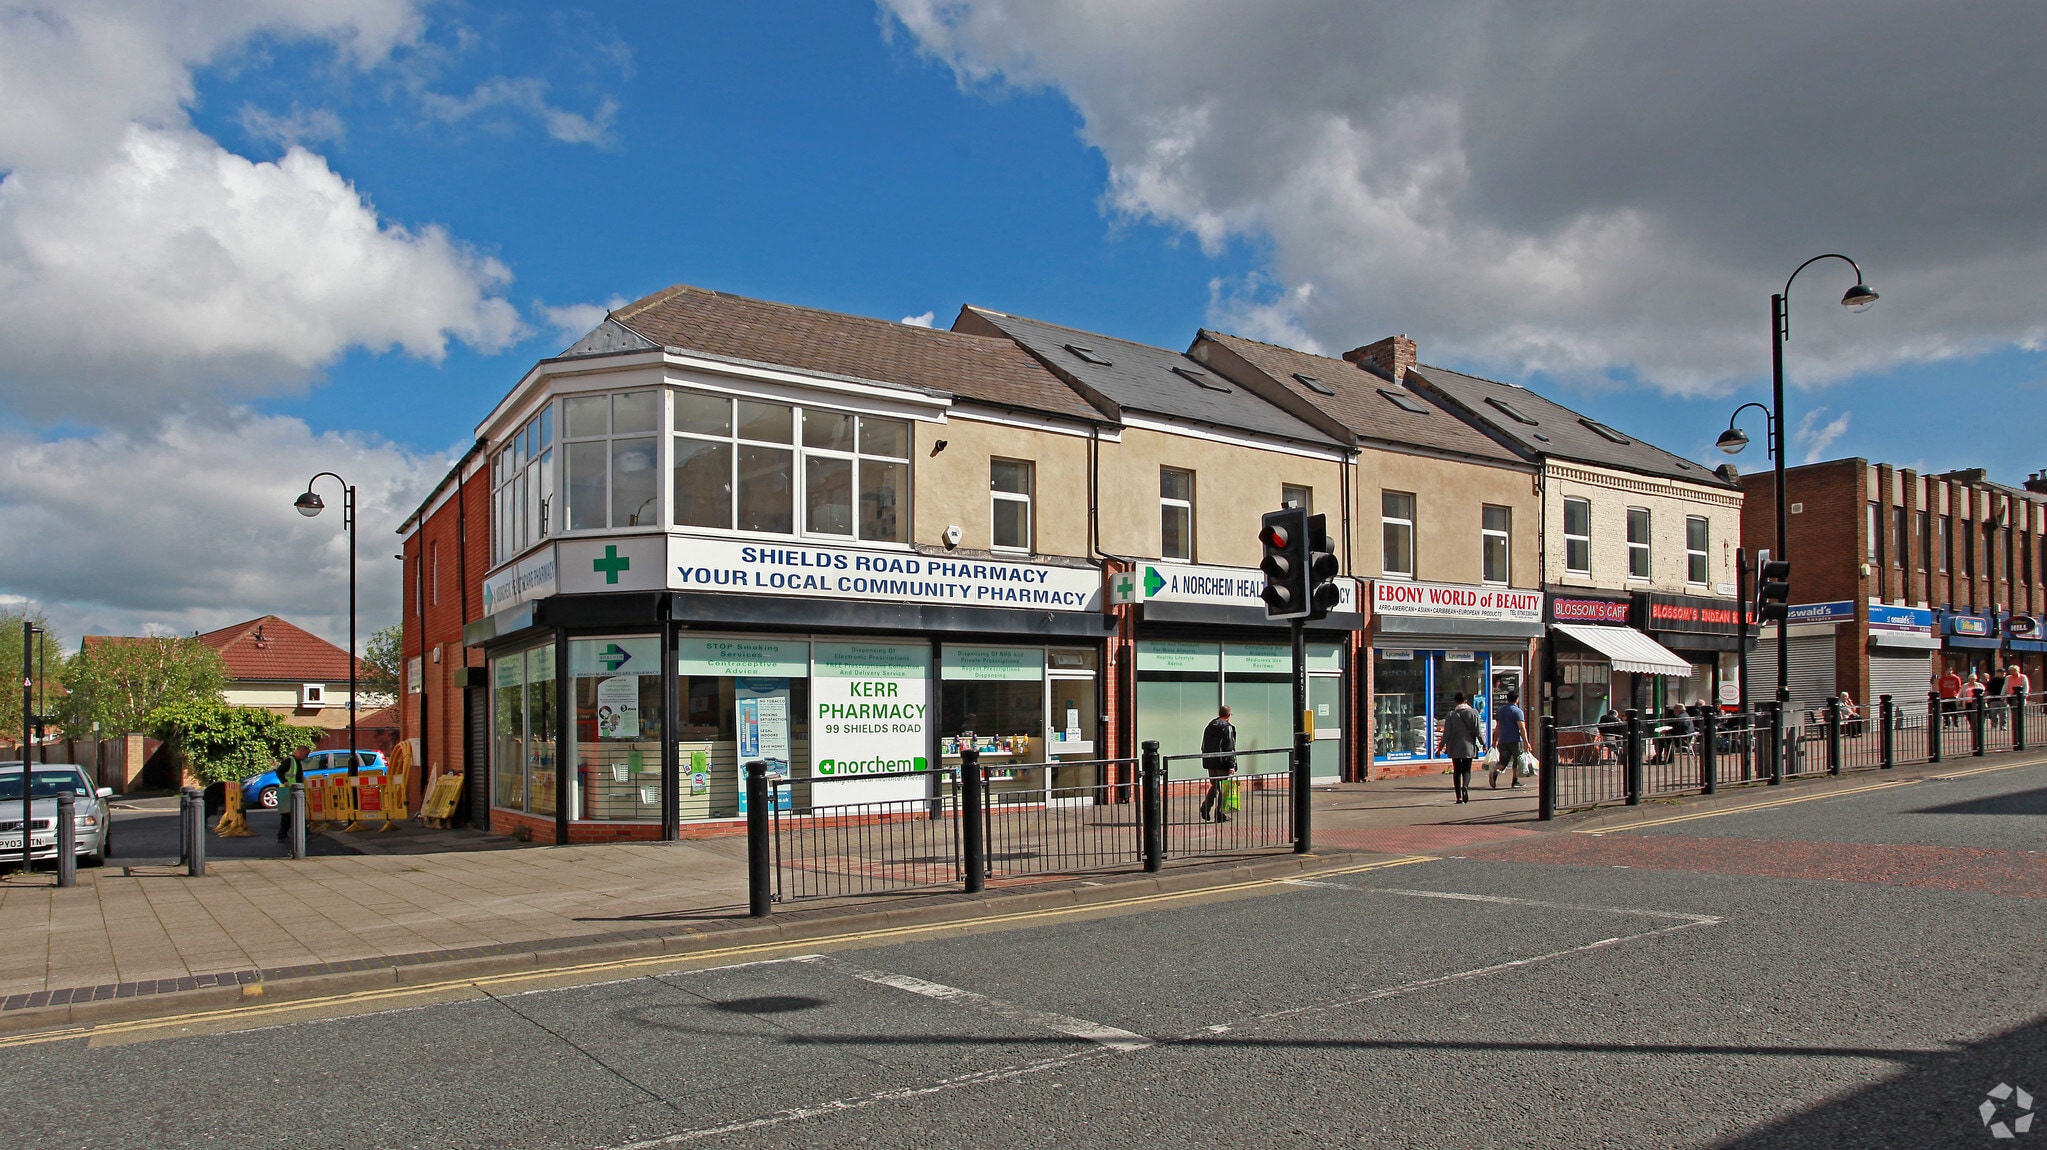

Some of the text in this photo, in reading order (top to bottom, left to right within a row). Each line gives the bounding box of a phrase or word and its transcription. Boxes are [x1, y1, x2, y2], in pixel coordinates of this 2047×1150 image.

[741, 546, 1048, 583] SHIELDS ROAD PHARMACY
[677, 566, 1086, 606] YOUR LOCAL COMMUNITY PHARMACY
[1171, 574, 1179, 593] A
[1183, 575, 1233, 597] NORCHEM
[1378, 585, 1540, 610] EBONY WORLD of BEAUTY
[1555, 602, 1605, 617] BLOSSOM'S
[1652, 605, 1698, 620] BLOSSOM'S
[1701, 609, 1730, 622] INDIAN
[736, 644, 779, 652] Smoking
[851, 647, 886, 655] Dispensing
[957, 650, 990, 658] Dispensing
[707, 660, 777, 668] Contraceptive
[834, 653, 867, 661] Electronic
[854, 669, 880, 677] Delivery
[850, 681, 898, 697] KERR
[819, 703, 927, 719] PHARMACY
[825, 724, 921, 733] 99 SHIELDS ROAD
[837, 755, 912, 774] norchem
